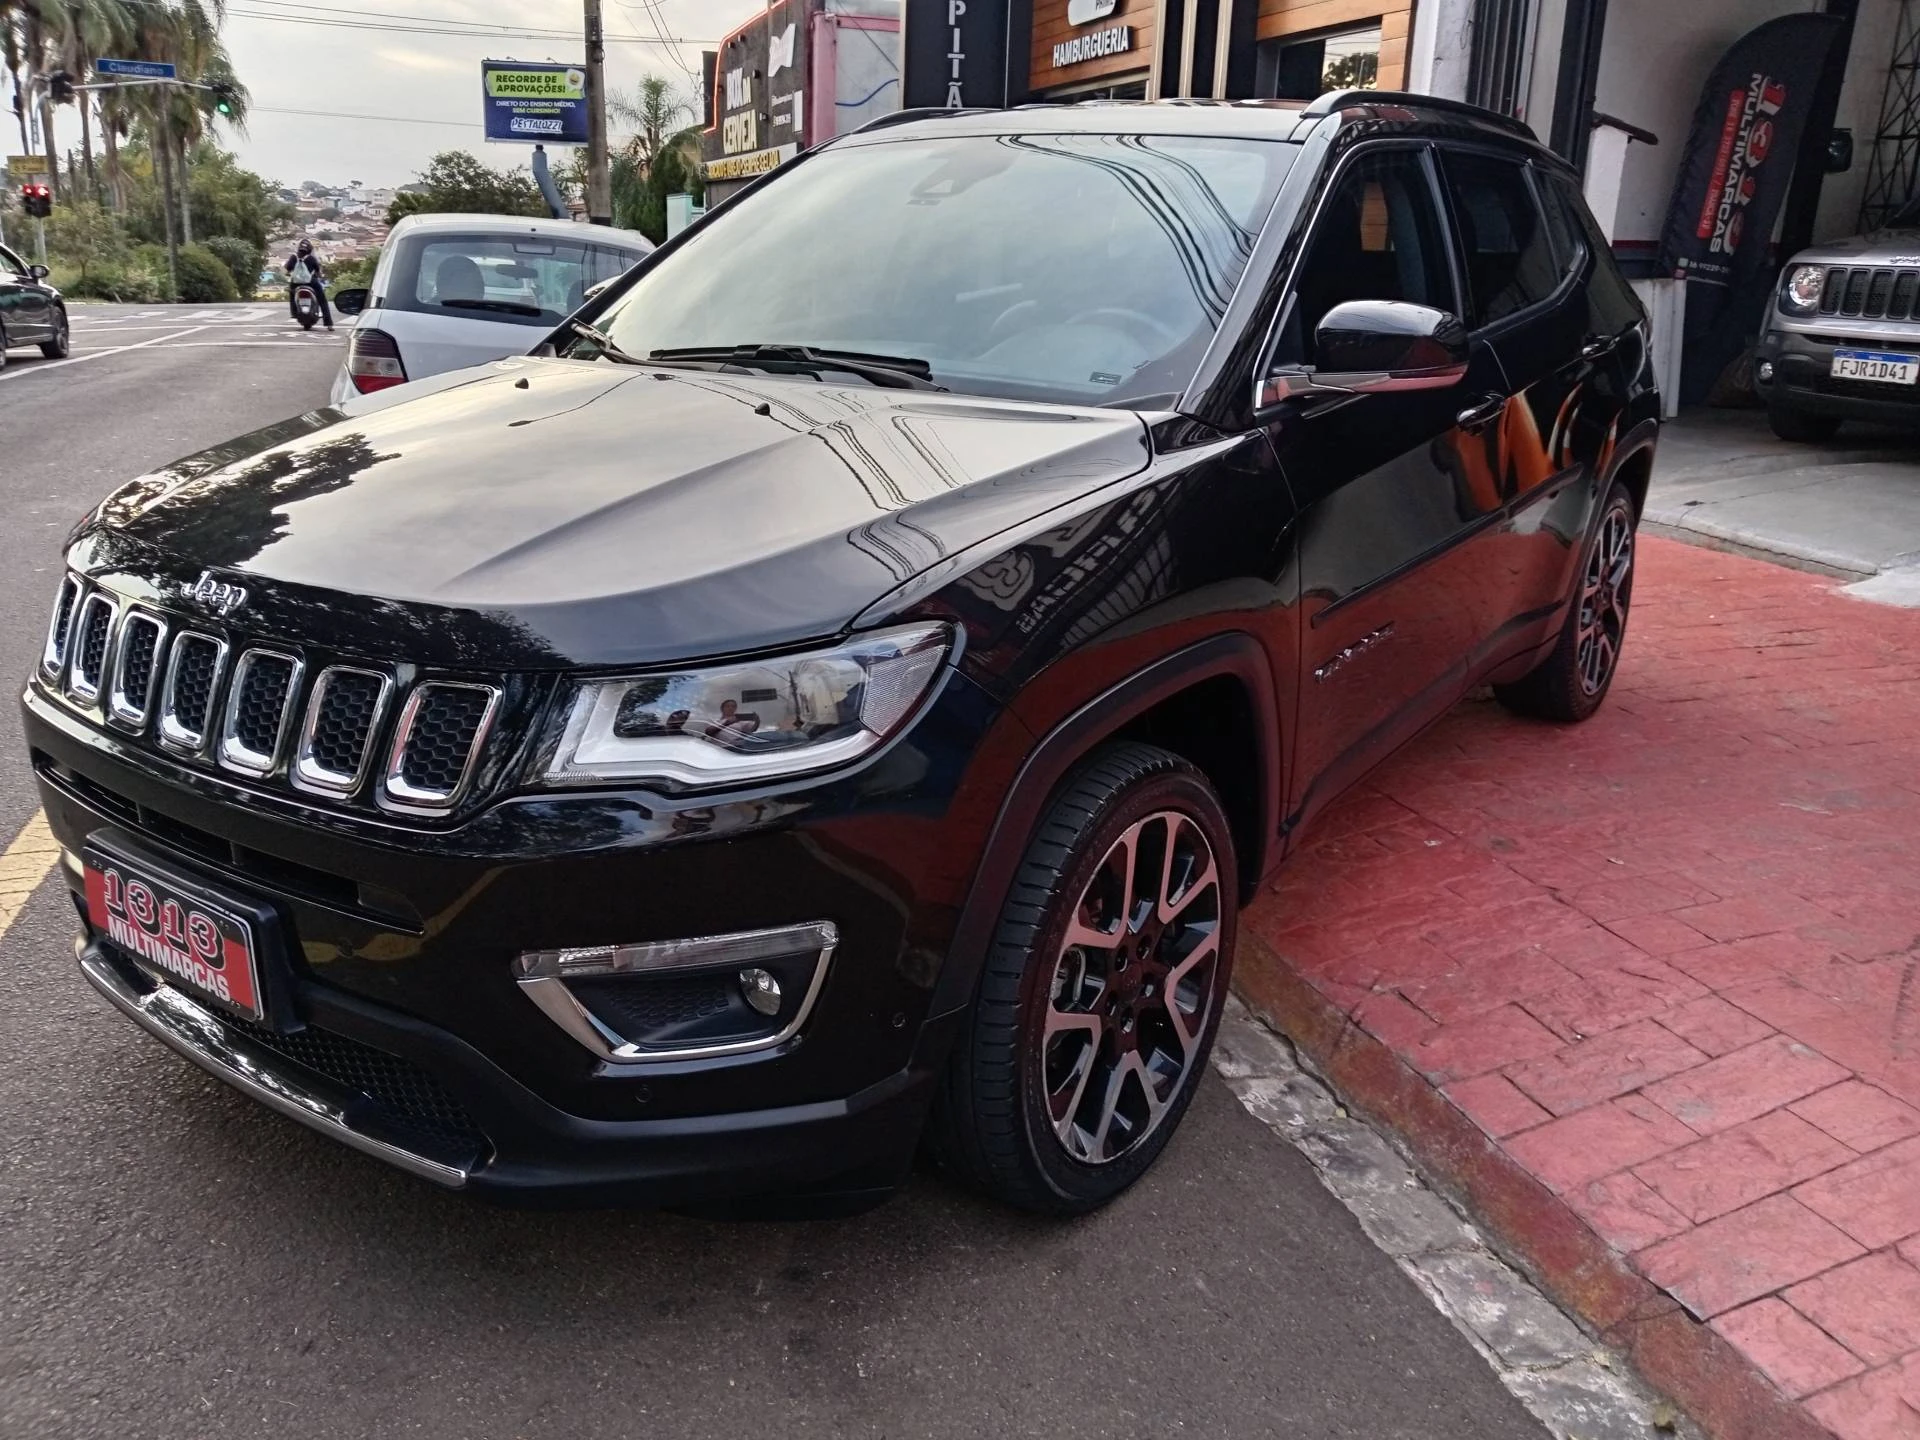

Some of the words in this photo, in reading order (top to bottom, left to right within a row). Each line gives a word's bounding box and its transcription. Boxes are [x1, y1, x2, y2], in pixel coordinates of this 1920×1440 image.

[1053, 25, 1129, 67] HAMBURGUERIA
[108, 62, 164, 75] Claudiano
[496, 75, 542, 83] RECORDE
[544, 75, 557, 83] DE
[496, 83, 566, 95] APROVAÇÕES!
[511, 118, 562, 132] PESTALOZZI
[723, 109, 757, 155] CERVEJA
[1709, 73, 1762, 253] MULTIMARCAS
[1840, 360, 1907, 380] FJR1D41
[181, 570, 248, 616] Jeep
[103, 867, 226, 971] 1313
[107, 914, 231, 1002] MULTIMARCAS
